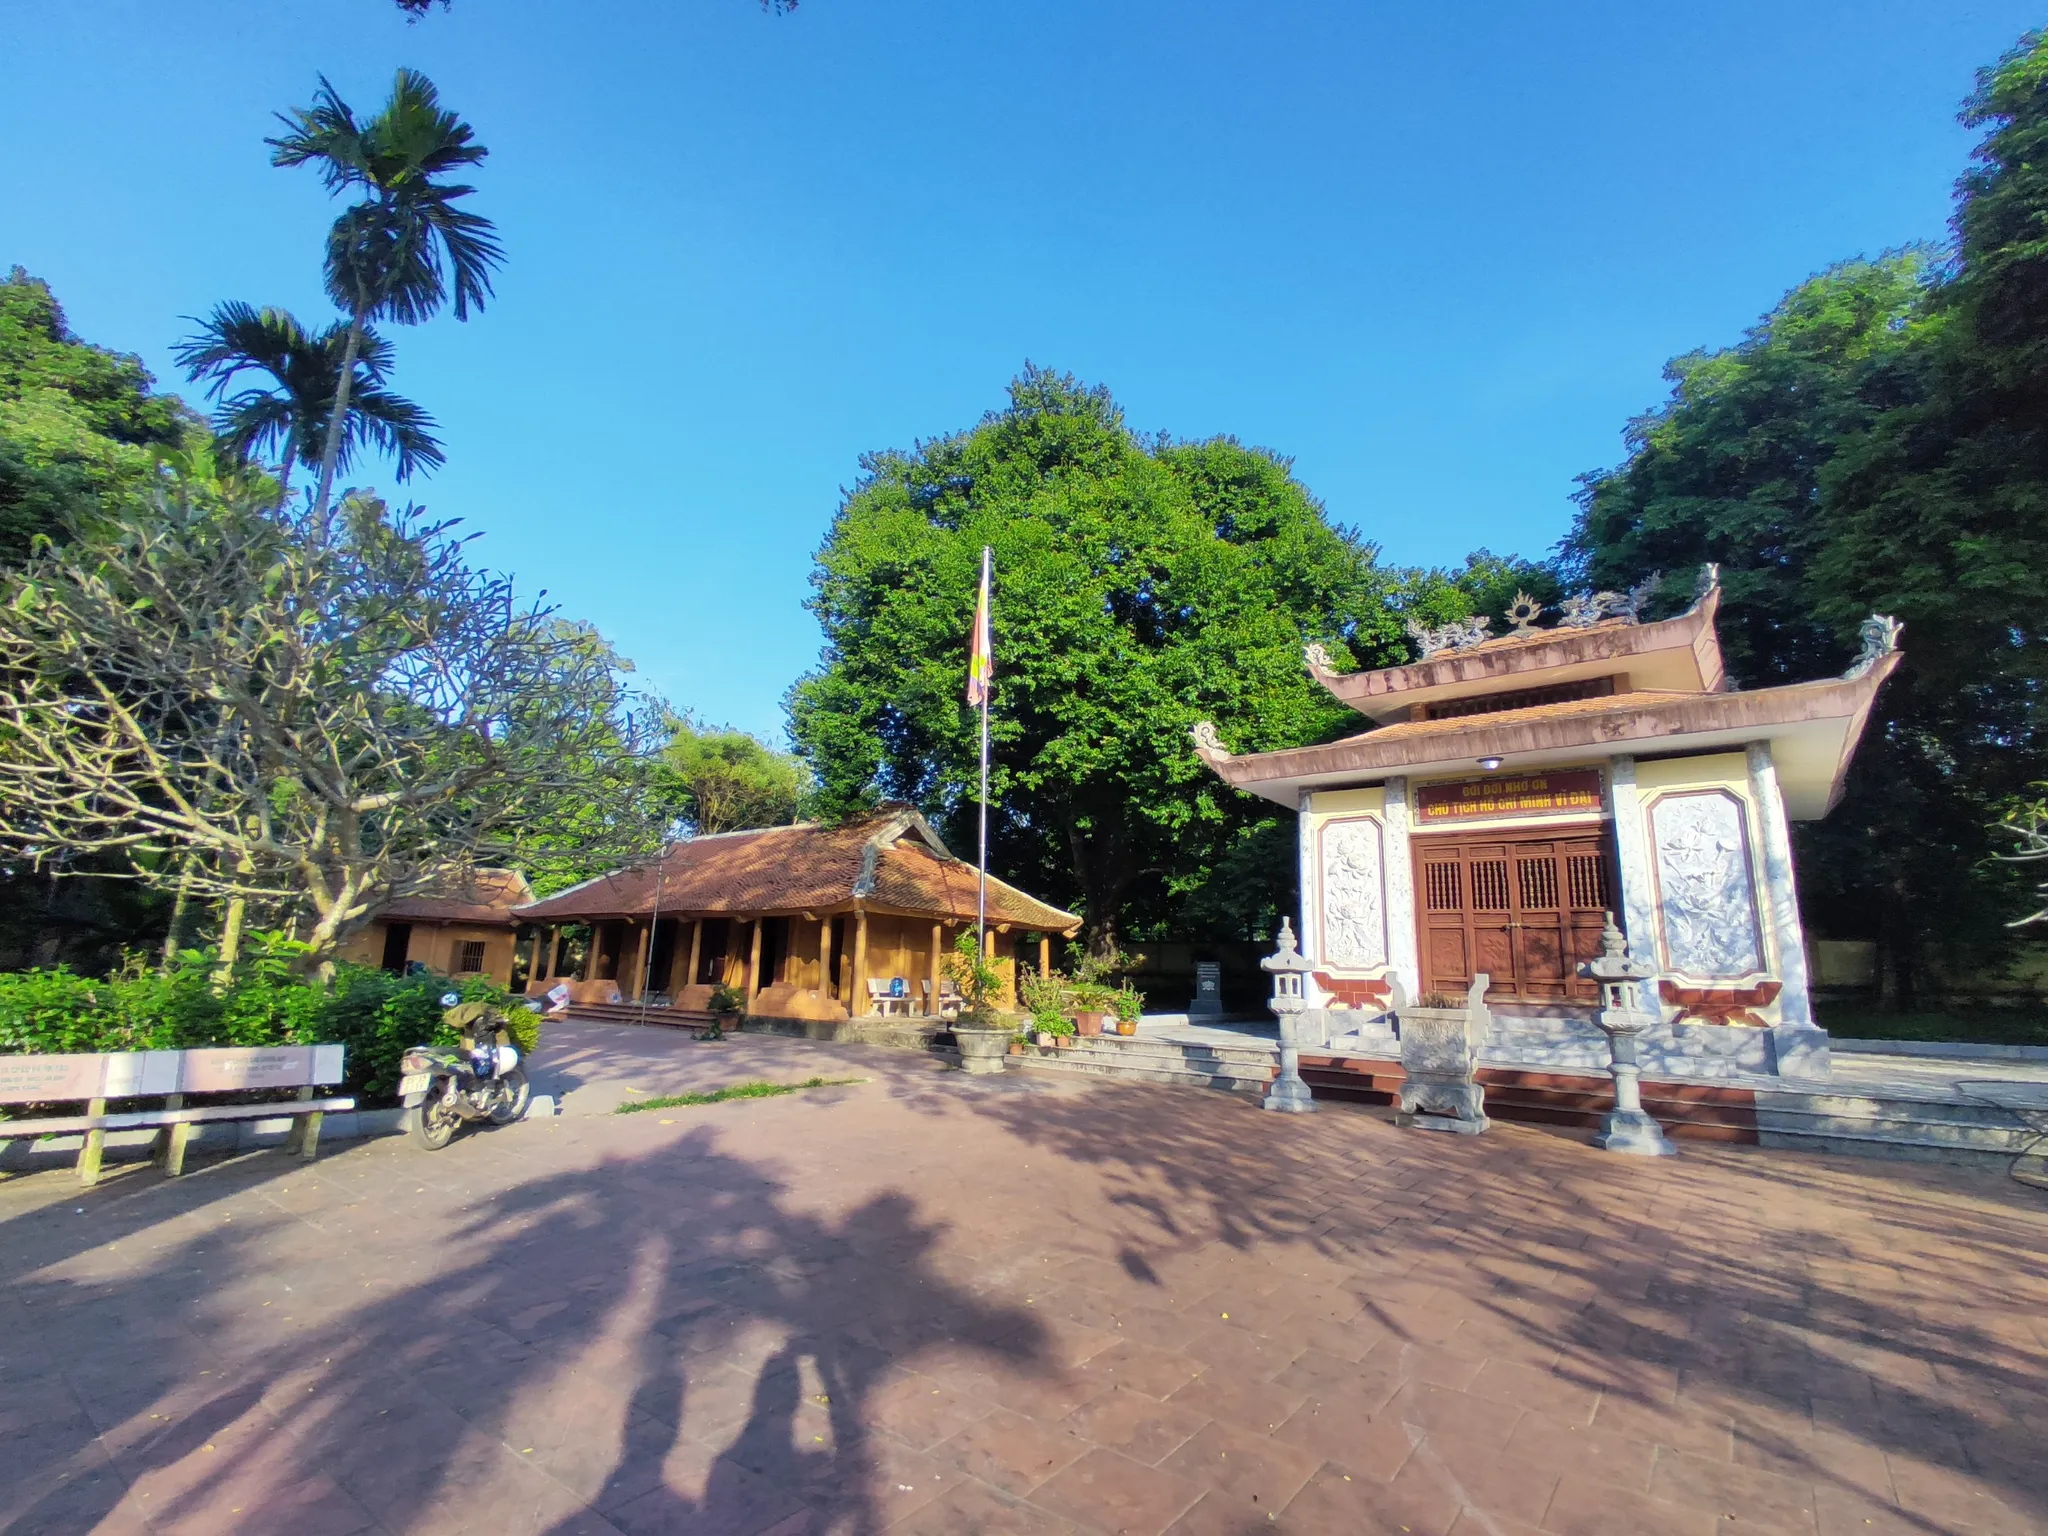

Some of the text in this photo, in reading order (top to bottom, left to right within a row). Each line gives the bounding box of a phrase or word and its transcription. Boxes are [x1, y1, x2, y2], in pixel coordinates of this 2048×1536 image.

[1452, 801, 1477, 816] TỊCH
[1519, 793, 1551, 809] MINH
[1554, 788, 1568, 807] VĨ
[1569, 790, 1592, 806] ĐẠI
